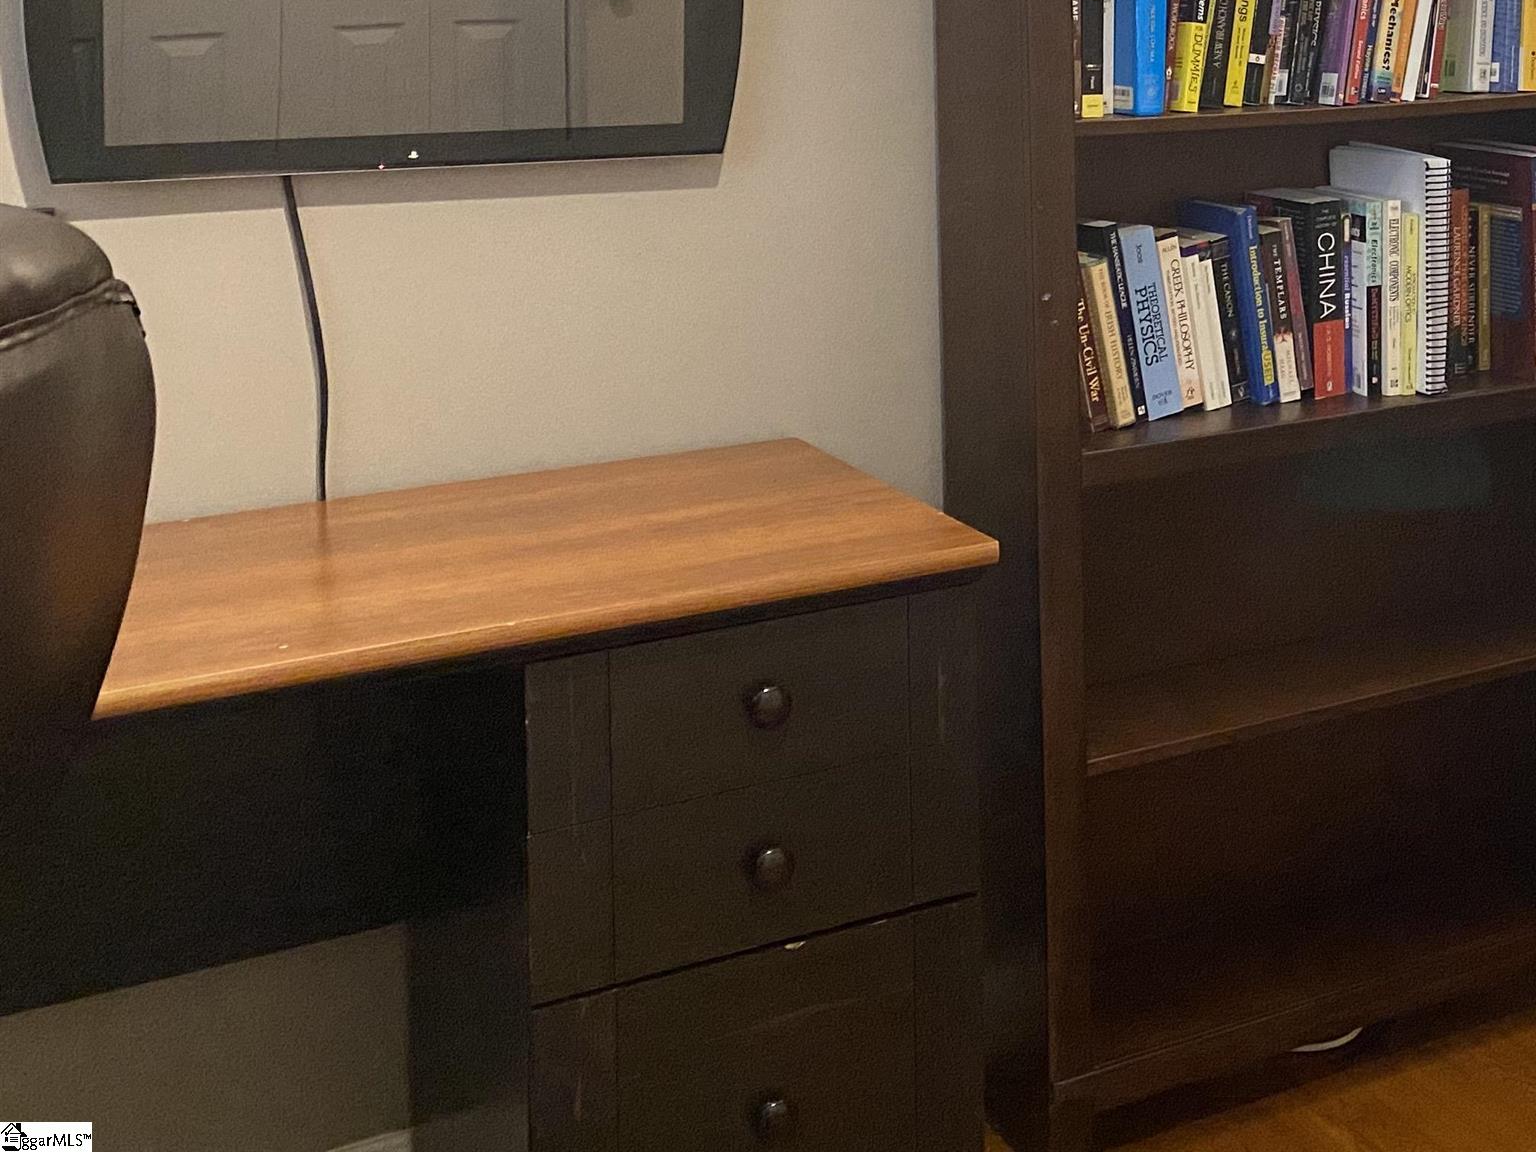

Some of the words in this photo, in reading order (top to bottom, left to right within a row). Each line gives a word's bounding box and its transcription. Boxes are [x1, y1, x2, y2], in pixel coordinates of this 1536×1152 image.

[1215, 6, 1229, 40] BRANCH
[1187, 33, 1203, 93] DUMMIES
[1212, 41, 1224, 60] NEW
[1109, 232, 1117, 245] THE
[1134, 244, 1144, 263] Joos
[1389, 219, 1399, 256] ELECTRONIC
[1451, 226, 1461, 275] LAURENCE
[1110, 246, 1123, 282] HANSEATIC
[1170, 258, 1185, 296] GREEK
[1220, 263, 1229, 280] THE
[1248, 245, 1264, 305] Introduction
[1317, 232, 1336, 318] CHINA
[1389, 260, 1399, 301] COMPONENTS
[1117, 283, 1128, 309] LEAGUE
[1222, 282, 1234, 318] CANON
[1273, 259, 1287, 319] TEMPLARS
[1451, 278, 1461, 326] GARDNER
[1104, 310, 1115, 337] IRISH
[1135, 286, 1159, 367] PHYSICS
[1147, 282, 1168, 361] THEORETICAL
[1256, 307, 1264, 318] to
[1467, 282, 1476, 343] SURRENDER
[1176, 299, 1195, 370] PHILOSOPHY
[1258, 320, 1269, 352] Insura
[1078, 324, 1096, 375] Un-Civil
[1088, 377, 1101, 401] War
[1109, 339, 1123, 379] HISTORY
[1262, 354, 1272, 382] USED
